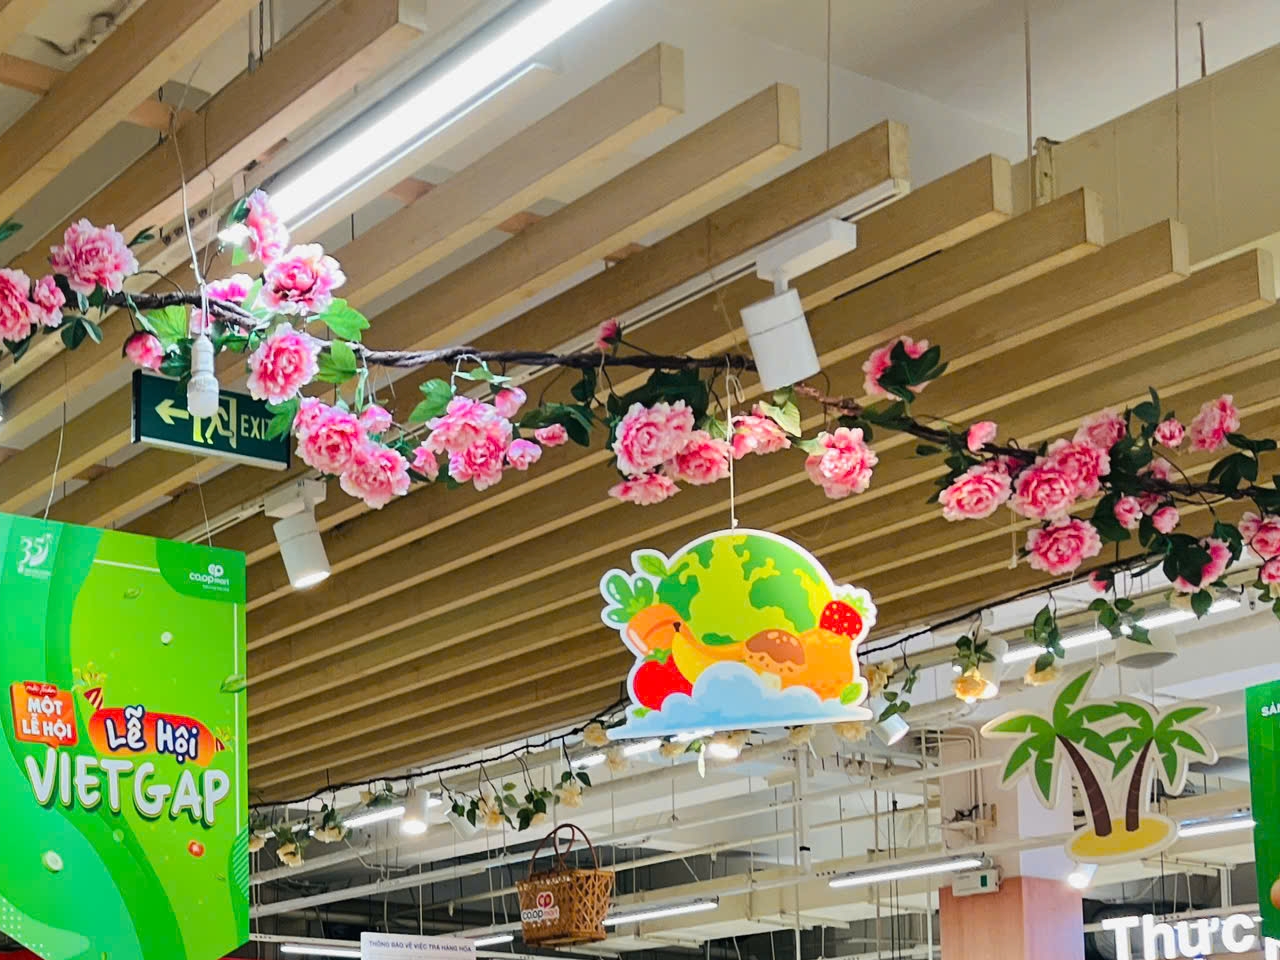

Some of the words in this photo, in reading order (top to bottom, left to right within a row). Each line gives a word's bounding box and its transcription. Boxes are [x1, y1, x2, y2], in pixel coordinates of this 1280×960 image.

[22, 713, 40, 735] LỄ
[42, 719, 72, 741] HỘI
[28, 695, 63, 717] MỘT
[105, 704, 146, 751] Lễ
[156, 717, 200, 764] Hội
[24, 747, 231, 826] VIETGAP
